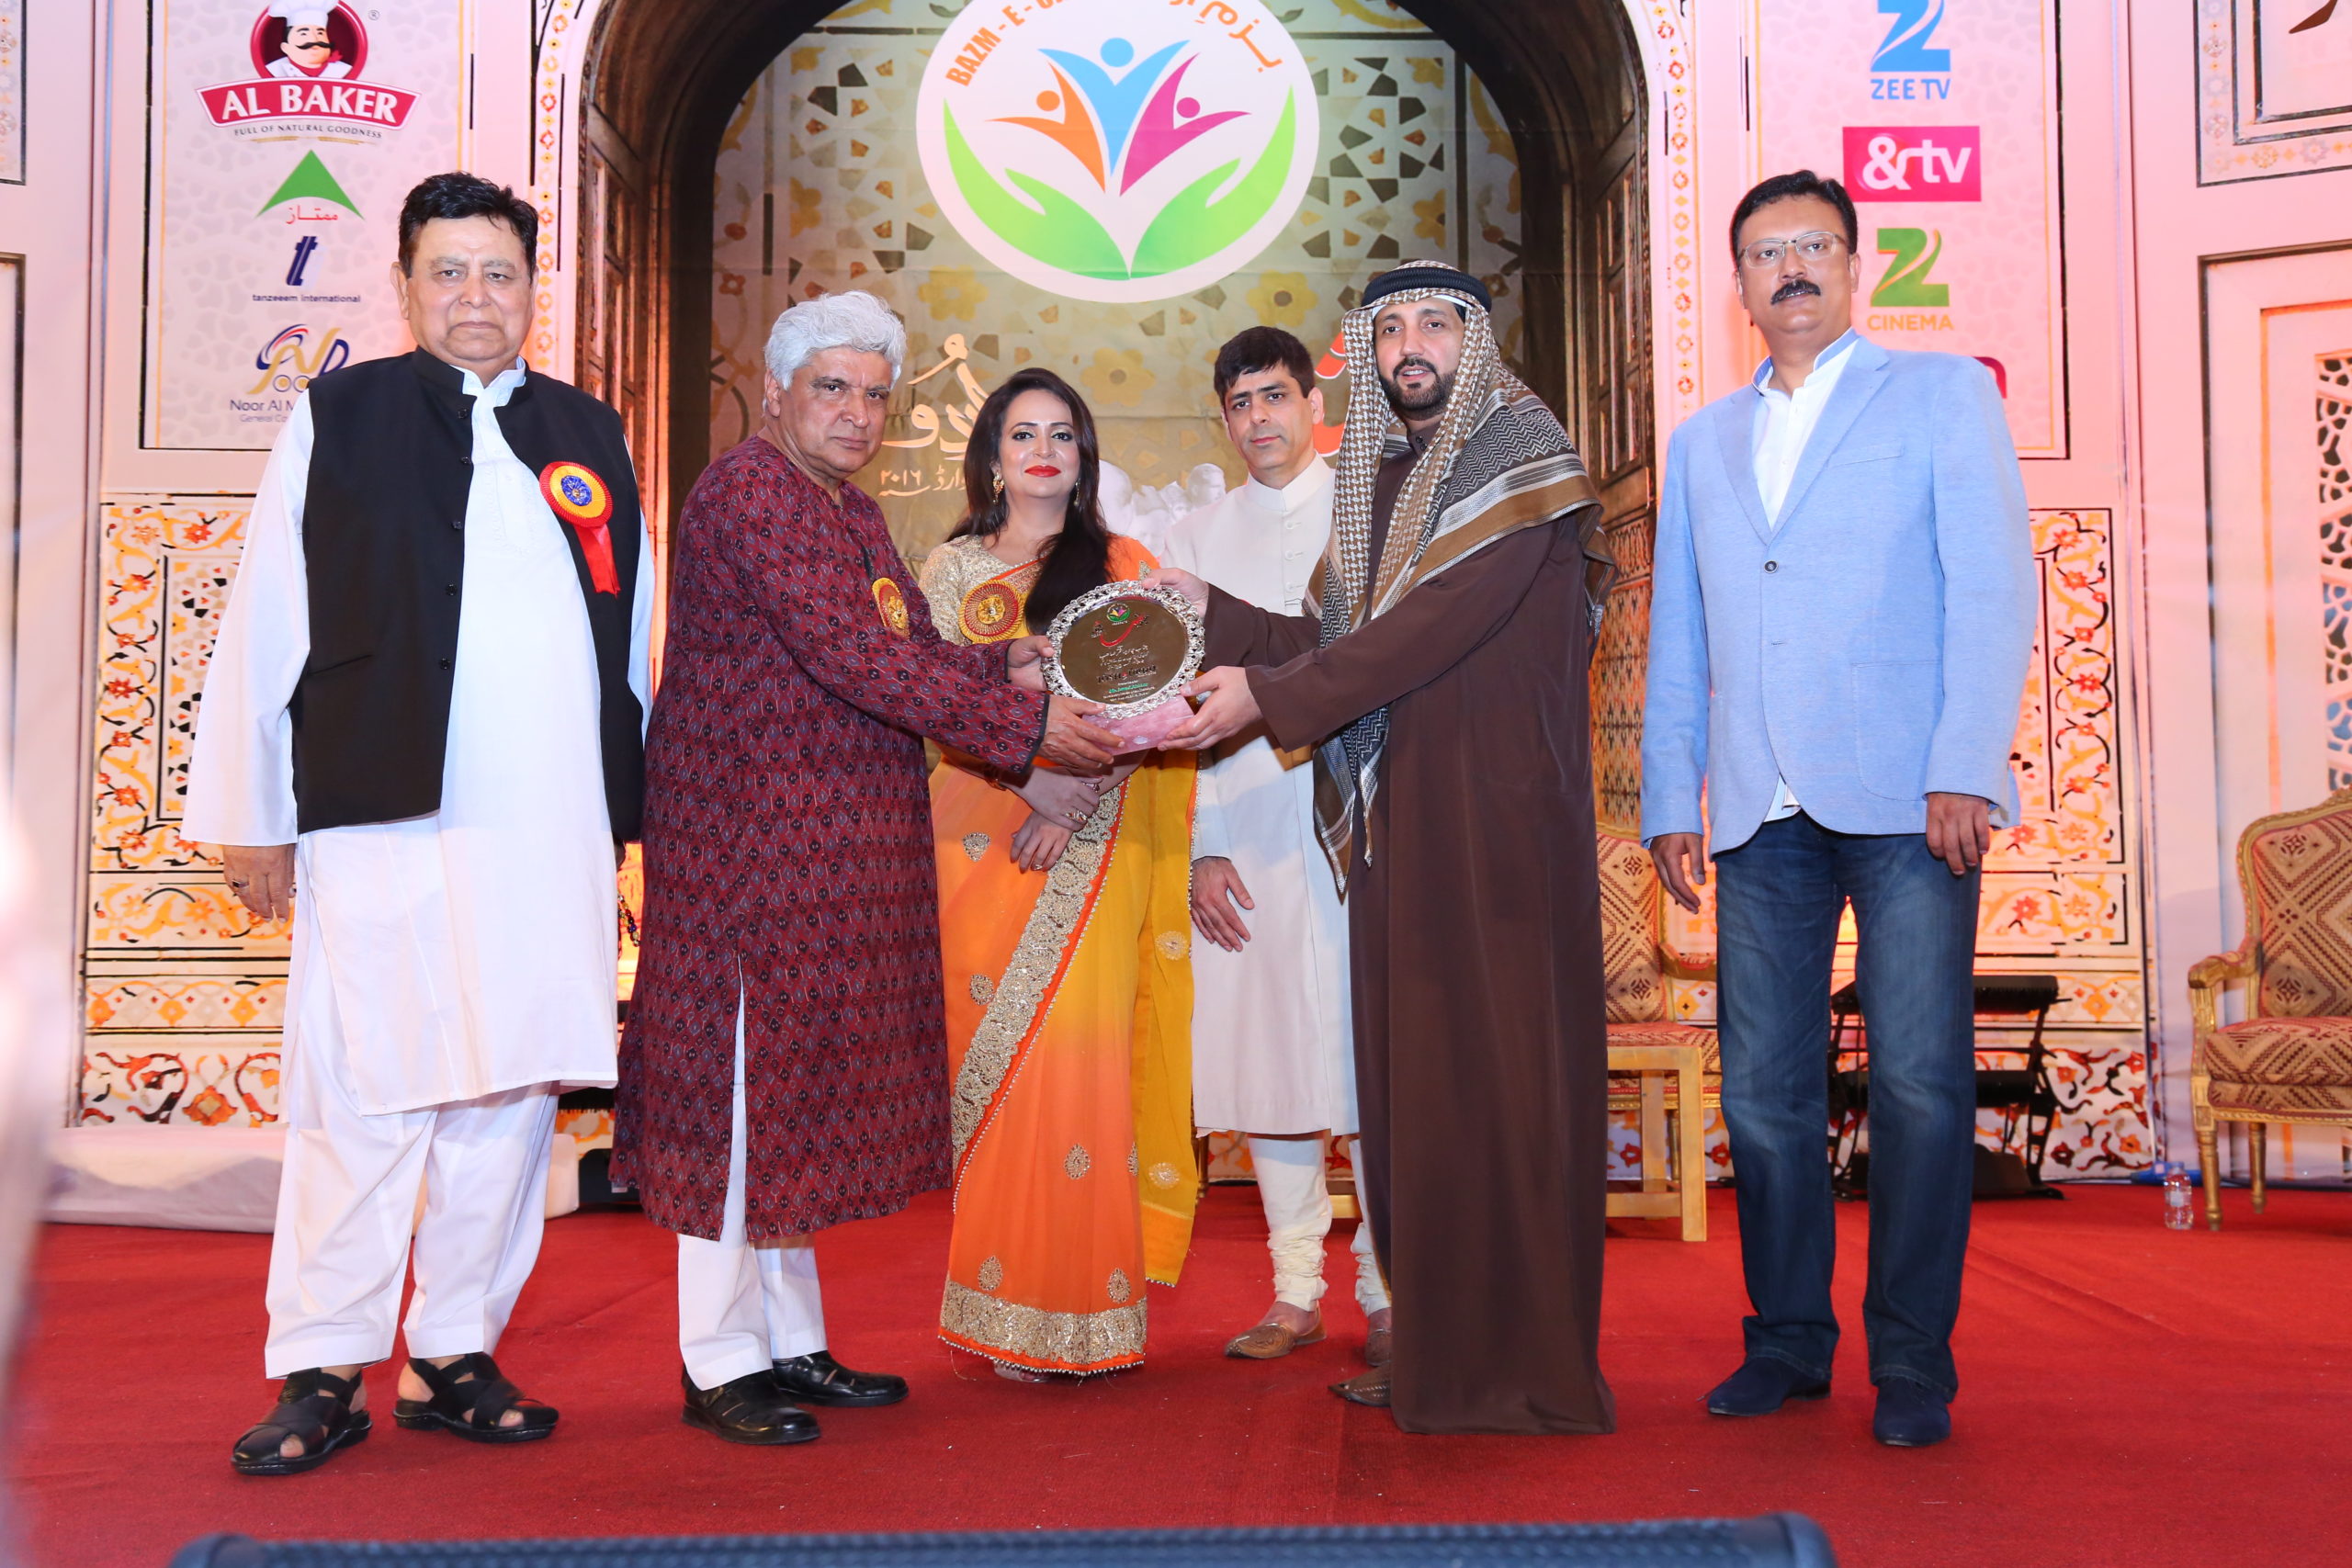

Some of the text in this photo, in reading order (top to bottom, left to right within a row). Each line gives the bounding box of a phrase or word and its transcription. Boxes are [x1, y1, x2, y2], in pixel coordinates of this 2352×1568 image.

[945, 27, 1001, 86] BAZM
[1870, 78, 1951, 100] ZEE TV
[222, 84, 398, 123] AL BAKER
[233, 124, 382, 139] FULL OF NATURAL GOODNESS
[1862, 136, 1973, 190] &tv
[300, 294, 361, 303] international
[1867, 314, 1954, 332] CINEMA
[230, 399, 265, 412] Noor
[267, 399, 282, 411] Al
[240, 413, 273, 423] General
